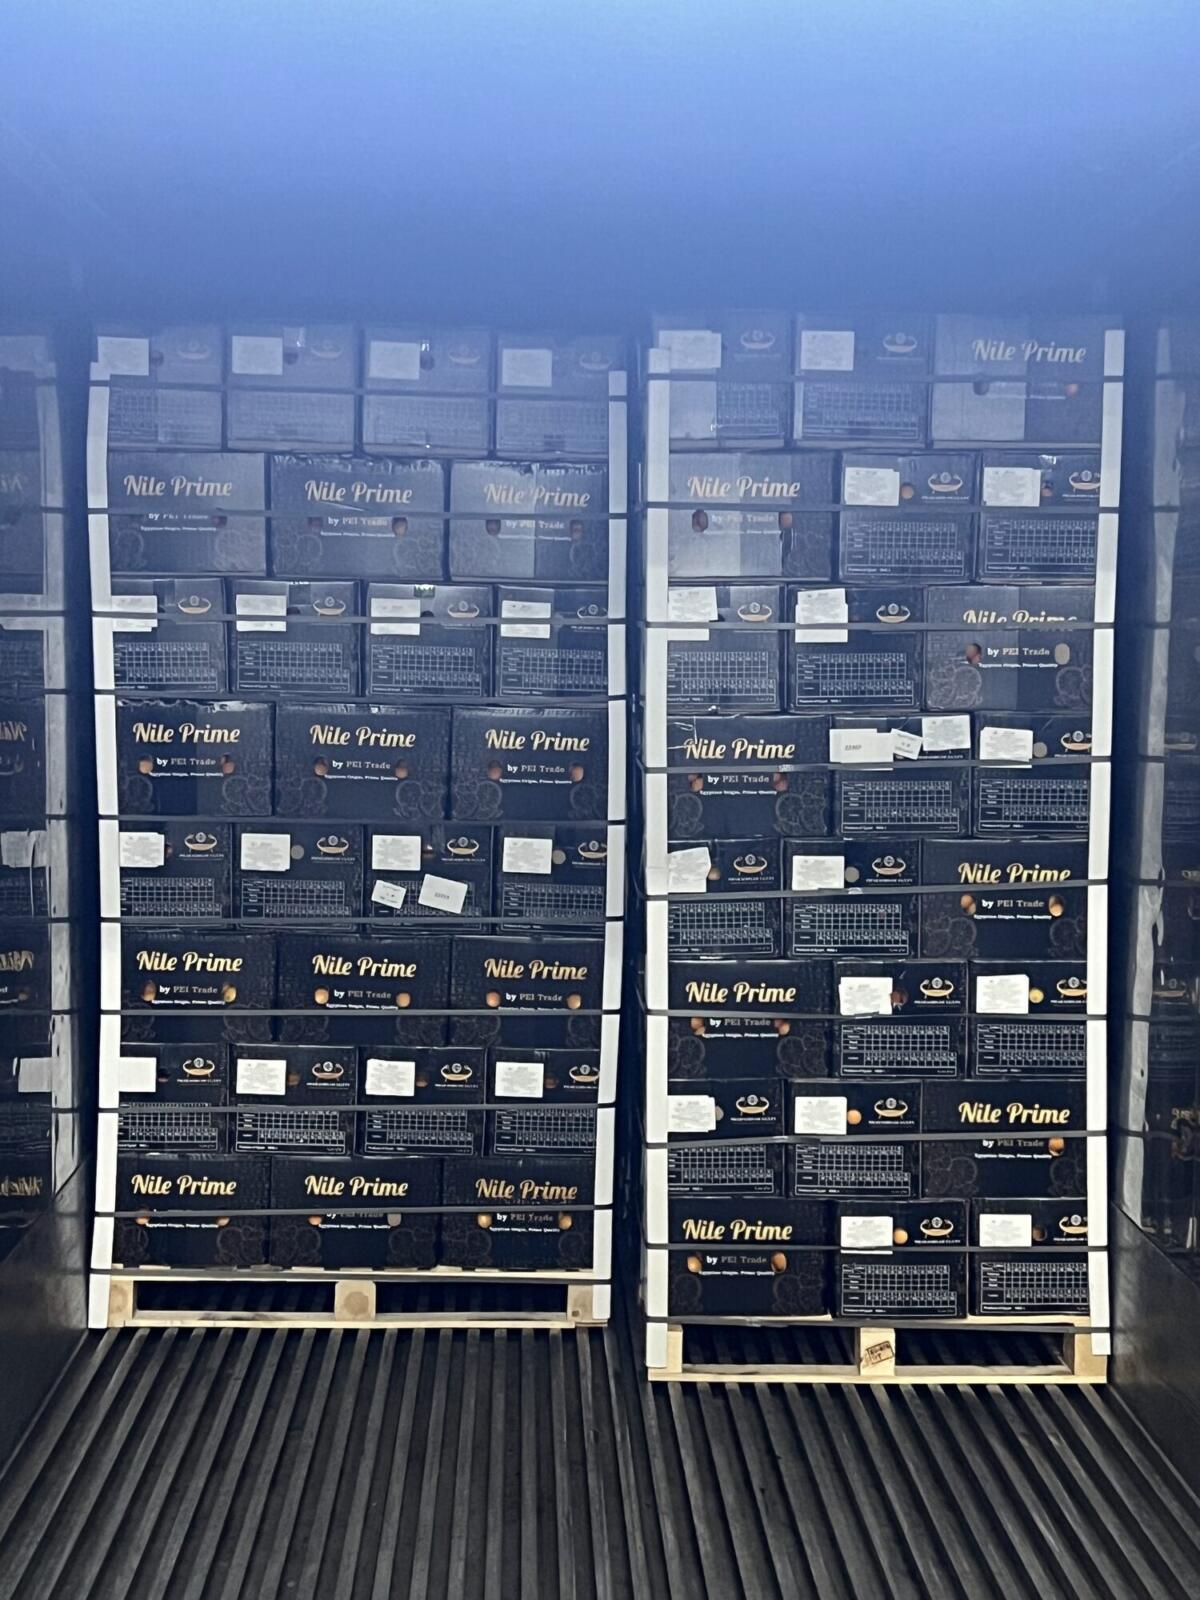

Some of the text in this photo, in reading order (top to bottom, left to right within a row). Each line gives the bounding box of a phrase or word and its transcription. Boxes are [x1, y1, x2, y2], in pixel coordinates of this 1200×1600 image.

[972, 339, 1086, 363] Nile Prime
[124, 474, 232, 496] Nile Prime
[304, 480, 412, 504] Nile Prime
[484, 483, 590, 508] Nile Prime
[688, 476, 800, 498] Nile Prime
[1012, 610, 1077, 623] Pri
[987, 647, 999, 657] by
[1022, 648, 1050, 656] Trade
[132, 722, 240, 743] Nile Prime
[310, 724, 416, 748] Nile Prime
[485, 729, 590, 752] Nile Prime
[684, 738, 795, 759] Nile Prime
[156, 758, 168, 767] by
[189, 758, 216, 766] Trade
[332, 760, 344, 769] by
[507, 764, 518, 773] by
[539, 765, 565, 773] Trade
[707, 775, 719, 784] by
[742, 775, 770, 783] Trade
[958, 862, 1071, 883] Nile Prime
[982, 899, 994, 909] by
[136, 950, 243, 972] Nile Prime
[312, 954, 417, 977] Nile Prime
[484, 958, 588, 980] Nile Prime
[159, 985, 171, 994] by
[192, 986, 218, 994] Trade
[334, 990, 345, 998] by
[366, 991, 391, 999] Trade
[506, 993, 517, 1002] by
[686, 981, 796, 1004] Nile Prime
[709, 1018, 722, 1027] by
[744, 1018, 771, 1026] Trade
[958, 1101, 1071, 1124] Nile Prime
[982, 1140, 994, 1148] by
[131, 1174, 237, 1195] Nile Prime
[304, 1175, 408, 1196] Nile Prime
[475, 1178, 578, 1200] Nile Prime
[497, 1213, 507, 1222] by
[682, 1219, 793, 1240] Nile Prime
[706, 1256, 718, 1265] by
[741, 1256, 767, 1264] Trade
